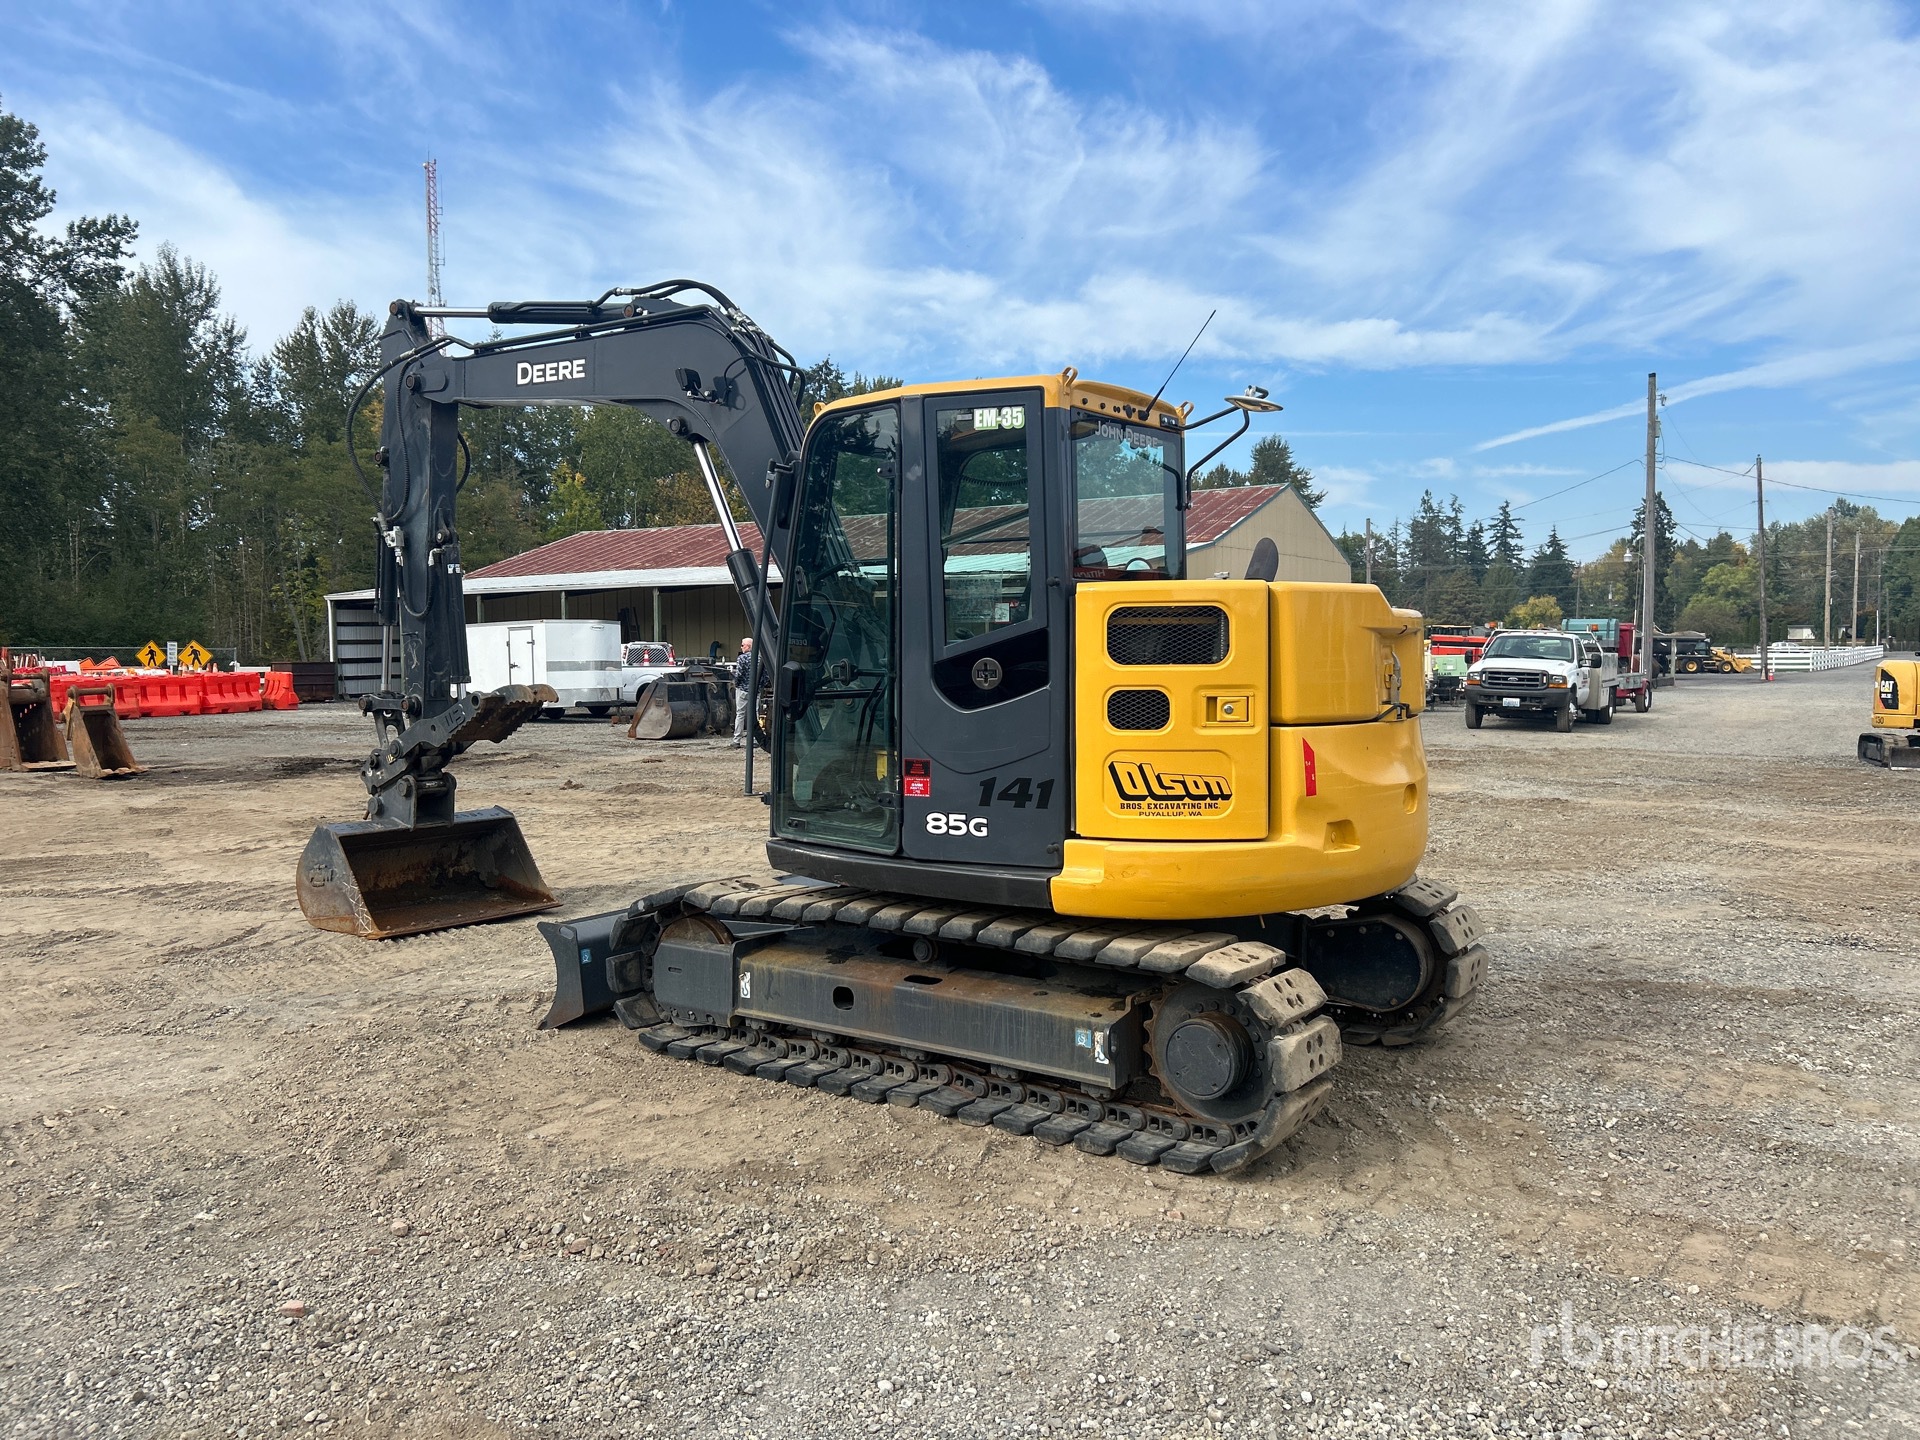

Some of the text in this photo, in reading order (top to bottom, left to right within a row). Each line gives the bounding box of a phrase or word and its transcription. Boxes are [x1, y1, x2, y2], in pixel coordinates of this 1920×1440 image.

[516, 359, 586, 386] DEERE
[973, 406, 1025, 431] EM-35
[1095, 420, 1159, 448] JOHN DEERE
[1880, 680, 1895, 693] CAT
[978, 776, 1056, 810] 141
[1120, 802, 1221, 810] BROS. EXCAVATING INC.
[925, 811, 989, 838] 85G
